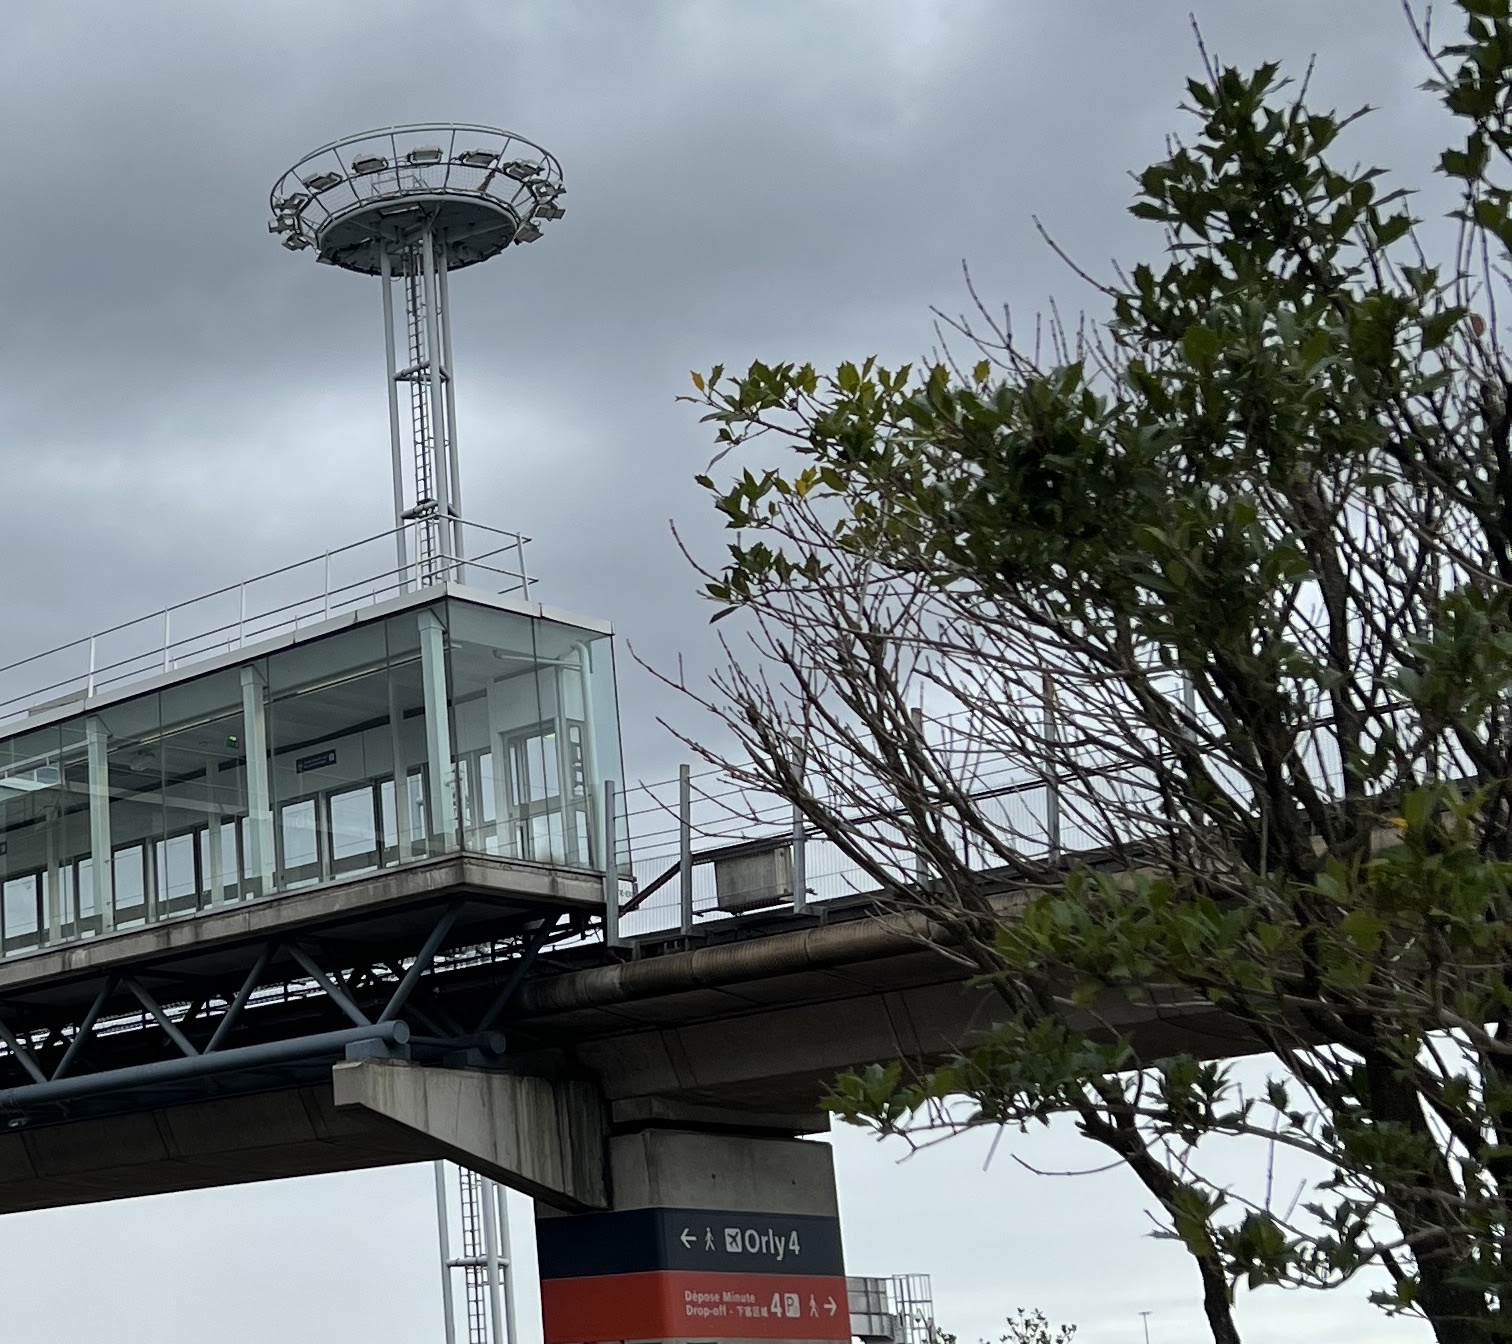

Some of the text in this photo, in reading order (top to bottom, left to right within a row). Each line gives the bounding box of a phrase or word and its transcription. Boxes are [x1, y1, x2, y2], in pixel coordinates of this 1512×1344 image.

[744, 1228, 801, 1261] Orly 4
[684, 1290, 756, 1304] Dépose Minute
[770, 1292, 783, 1318] 4
[685, 1304, 727, 1318] Drop-off
